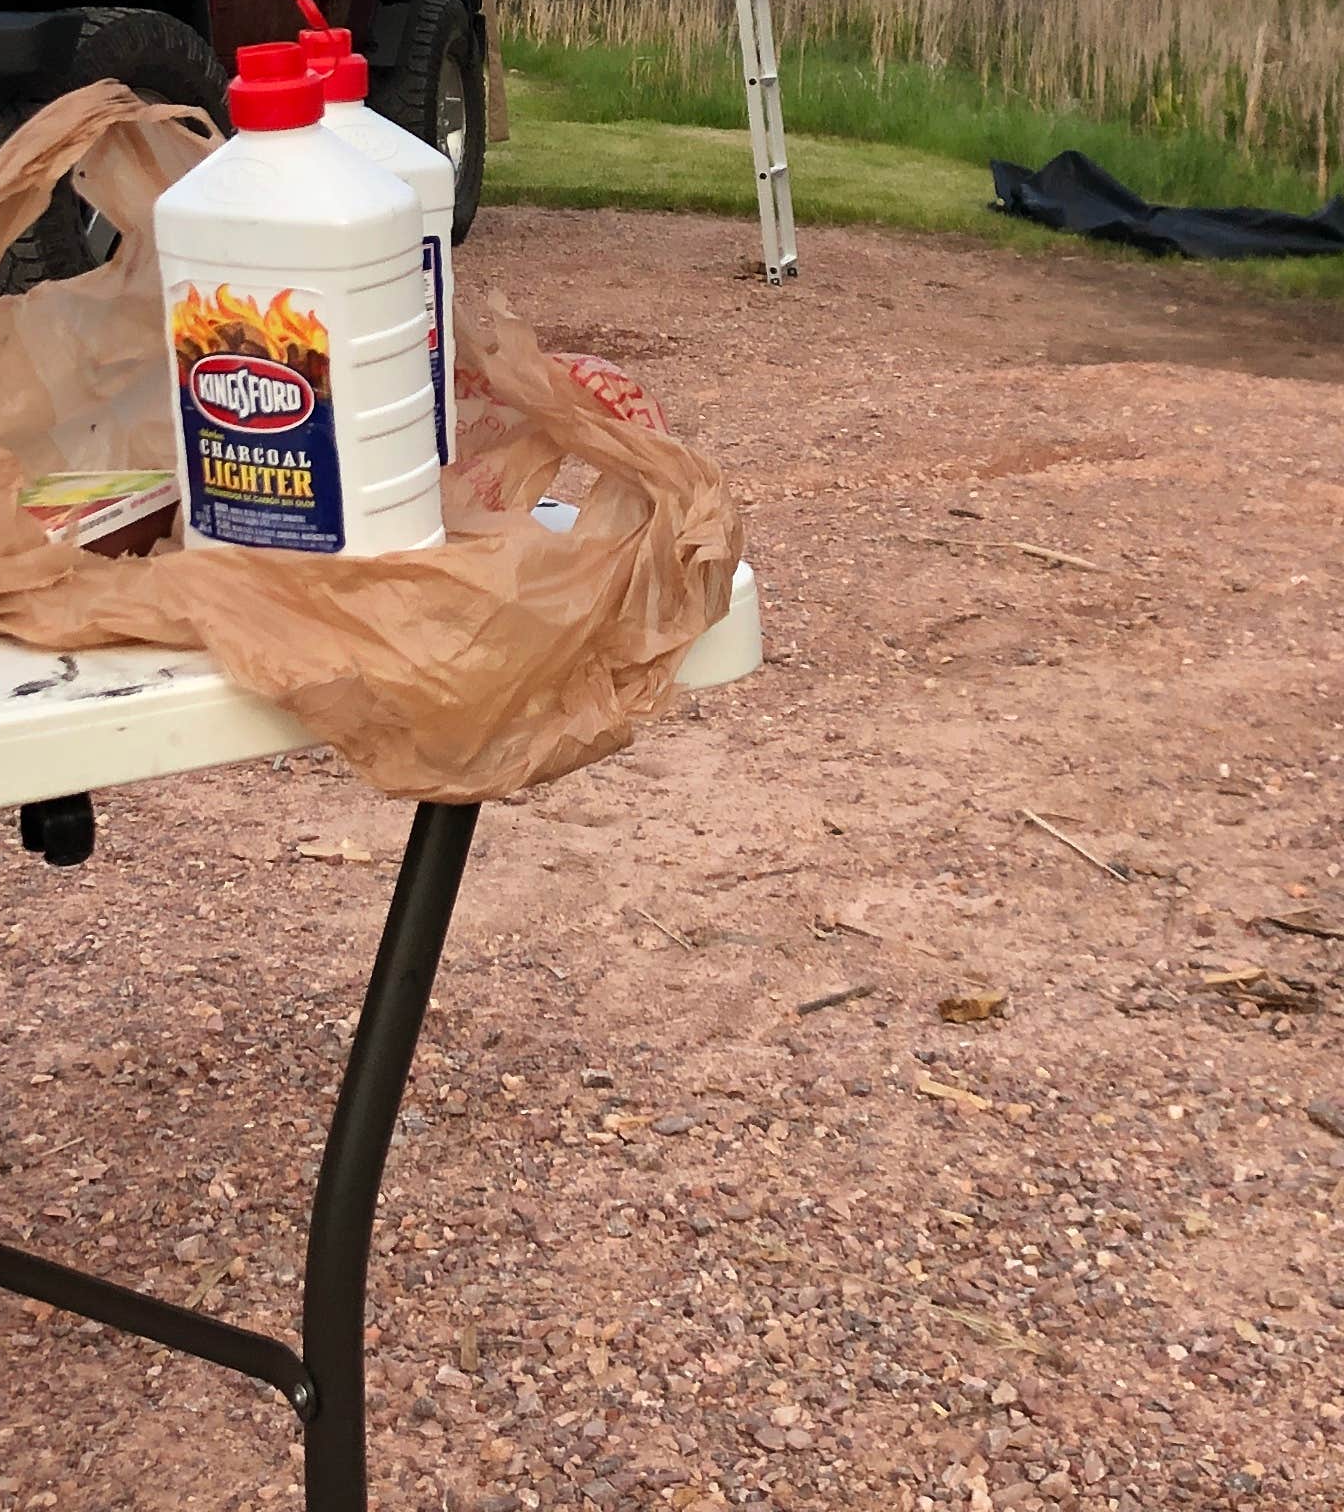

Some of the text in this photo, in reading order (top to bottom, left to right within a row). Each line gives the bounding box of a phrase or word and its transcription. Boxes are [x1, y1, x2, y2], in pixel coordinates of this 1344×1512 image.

[198, 368, 302, 419] KINGSFORD
[199, 438, 312, 468] CHARCOAL
[203, 457, 315, 497] LIGHTER
